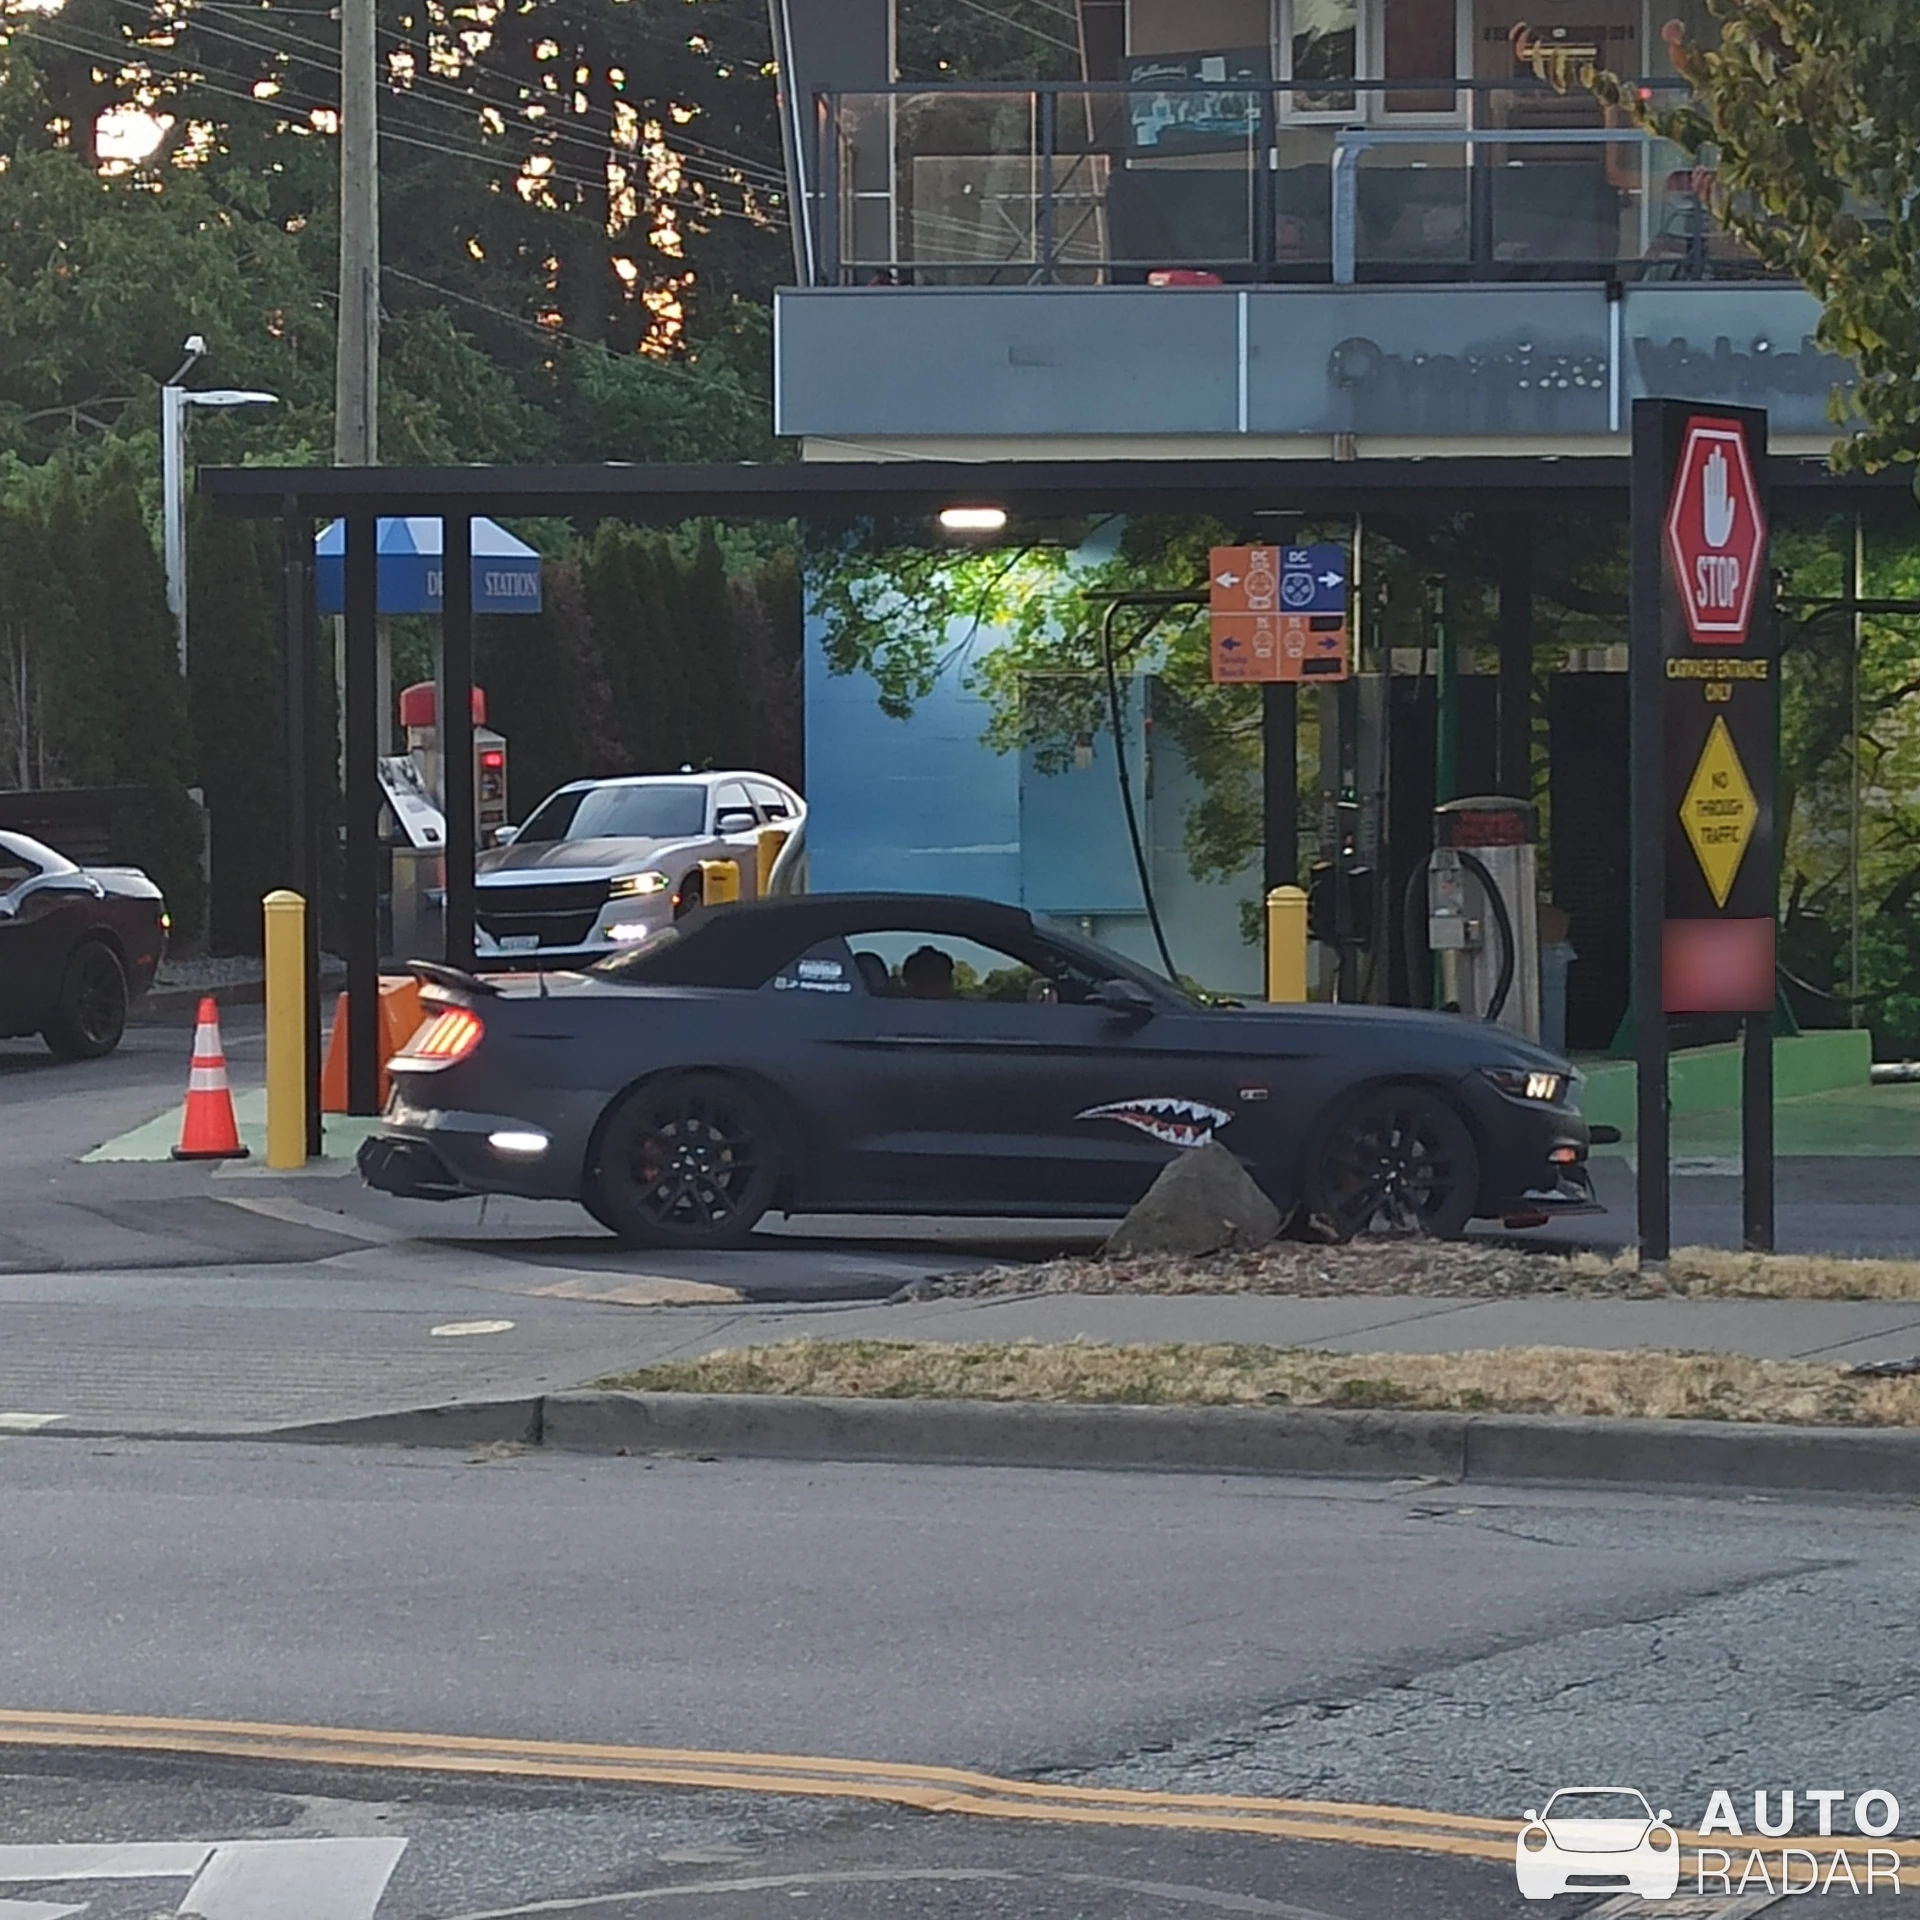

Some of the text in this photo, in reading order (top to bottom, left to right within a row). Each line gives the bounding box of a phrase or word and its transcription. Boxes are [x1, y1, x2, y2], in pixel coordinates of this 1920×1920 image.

[1289, 551, 1308, 562] DC
[484, 571, 538, 597] STATION
[1696, 556, 1740, 608] STOP
[1712, 771, 1728, 790] NO
[1701, 827, 1740, 844] TRAFFIC
